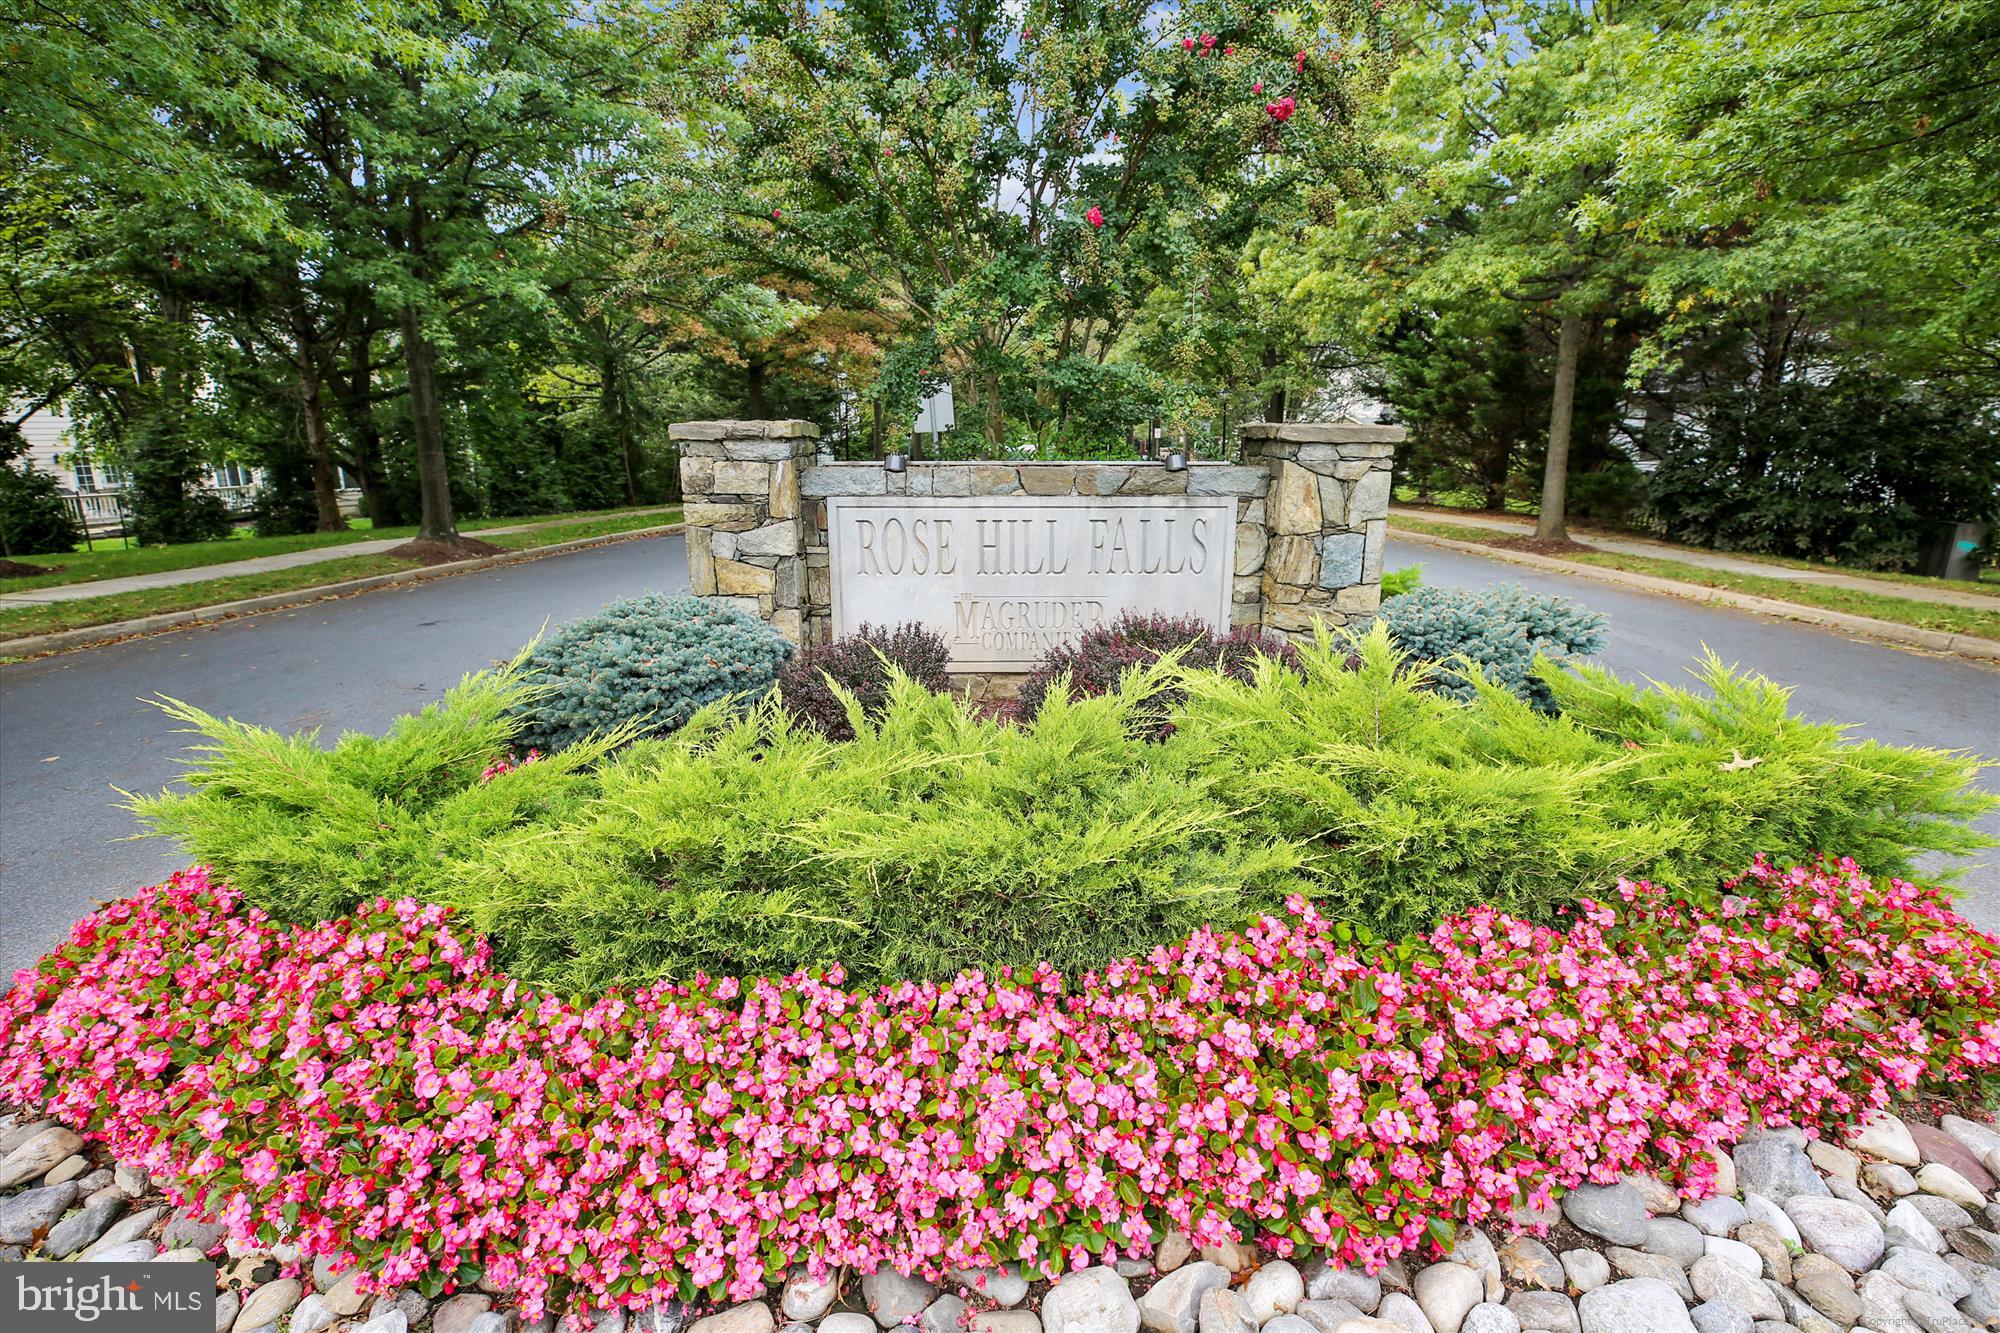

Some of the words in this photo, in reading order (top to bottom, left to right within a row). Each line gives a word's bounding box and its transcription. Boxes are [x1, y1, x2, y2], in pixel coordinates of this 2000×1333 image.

[855, 518, 957, 576] ROSE
[976, 518, 1068, 576] HILL
[1088, 517, 1208, 576] FALLS
